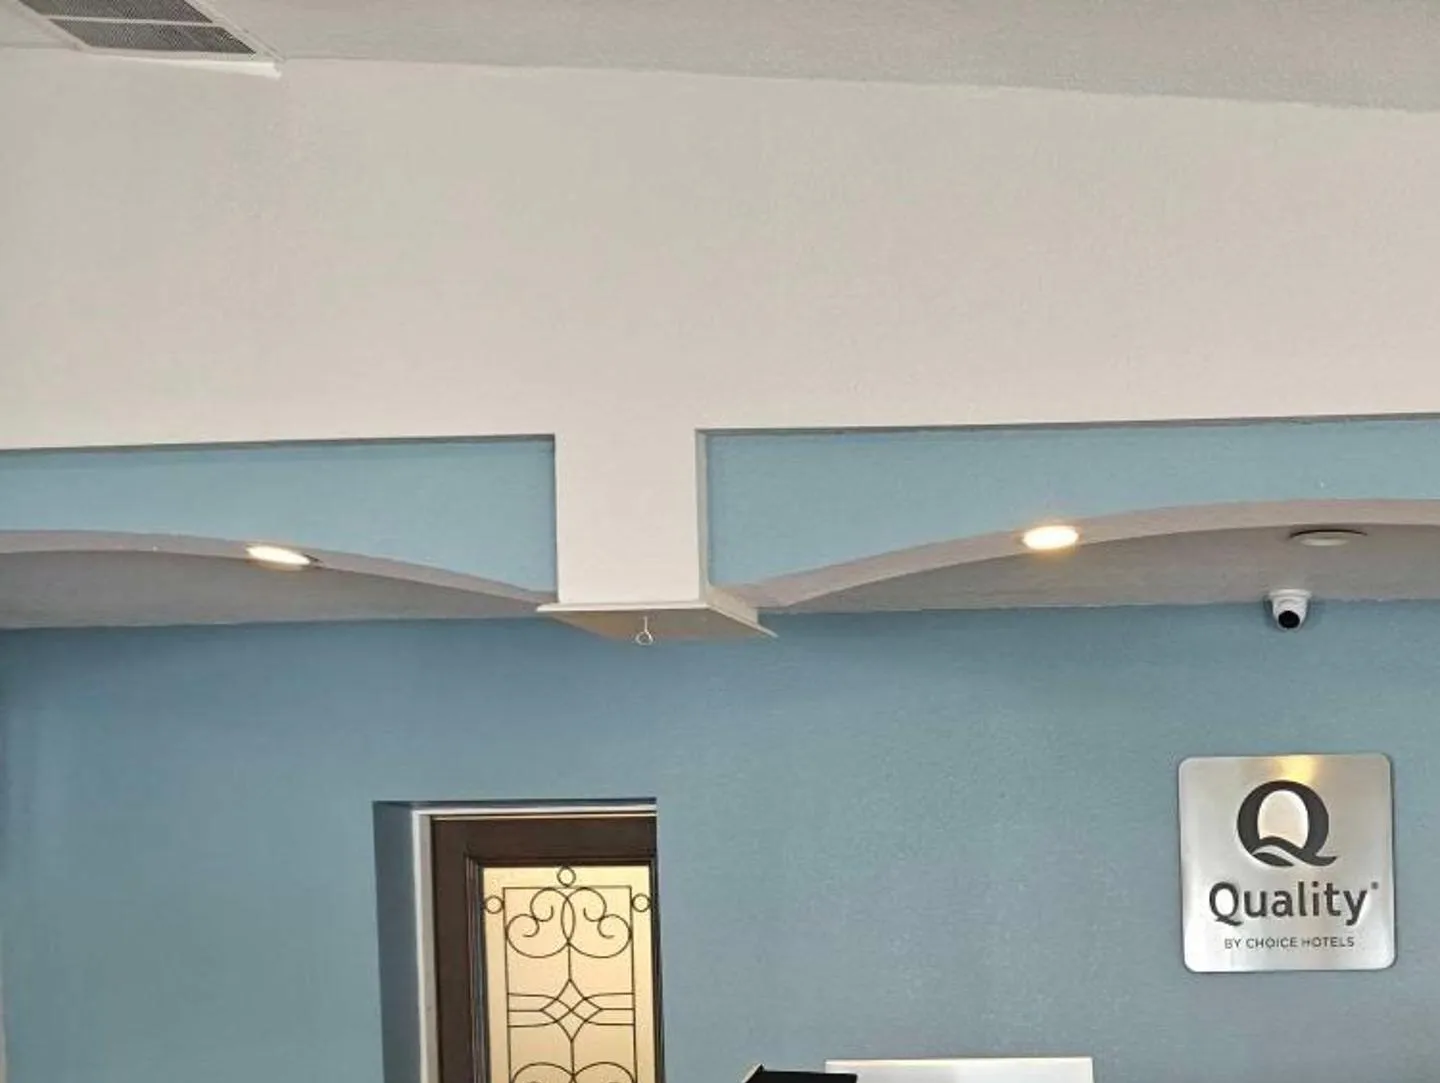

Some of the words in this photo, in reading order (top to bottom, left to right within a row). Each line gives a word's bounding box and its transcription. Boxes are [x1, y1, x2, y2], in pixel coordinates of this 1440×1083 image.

[1208, 881, 1368, 927] Quality
[1224, 938, 1242, 949] BY
[1246, 937, 1298, 949] CHOICE
[1301, 936, 1355, 948] HOTELS
